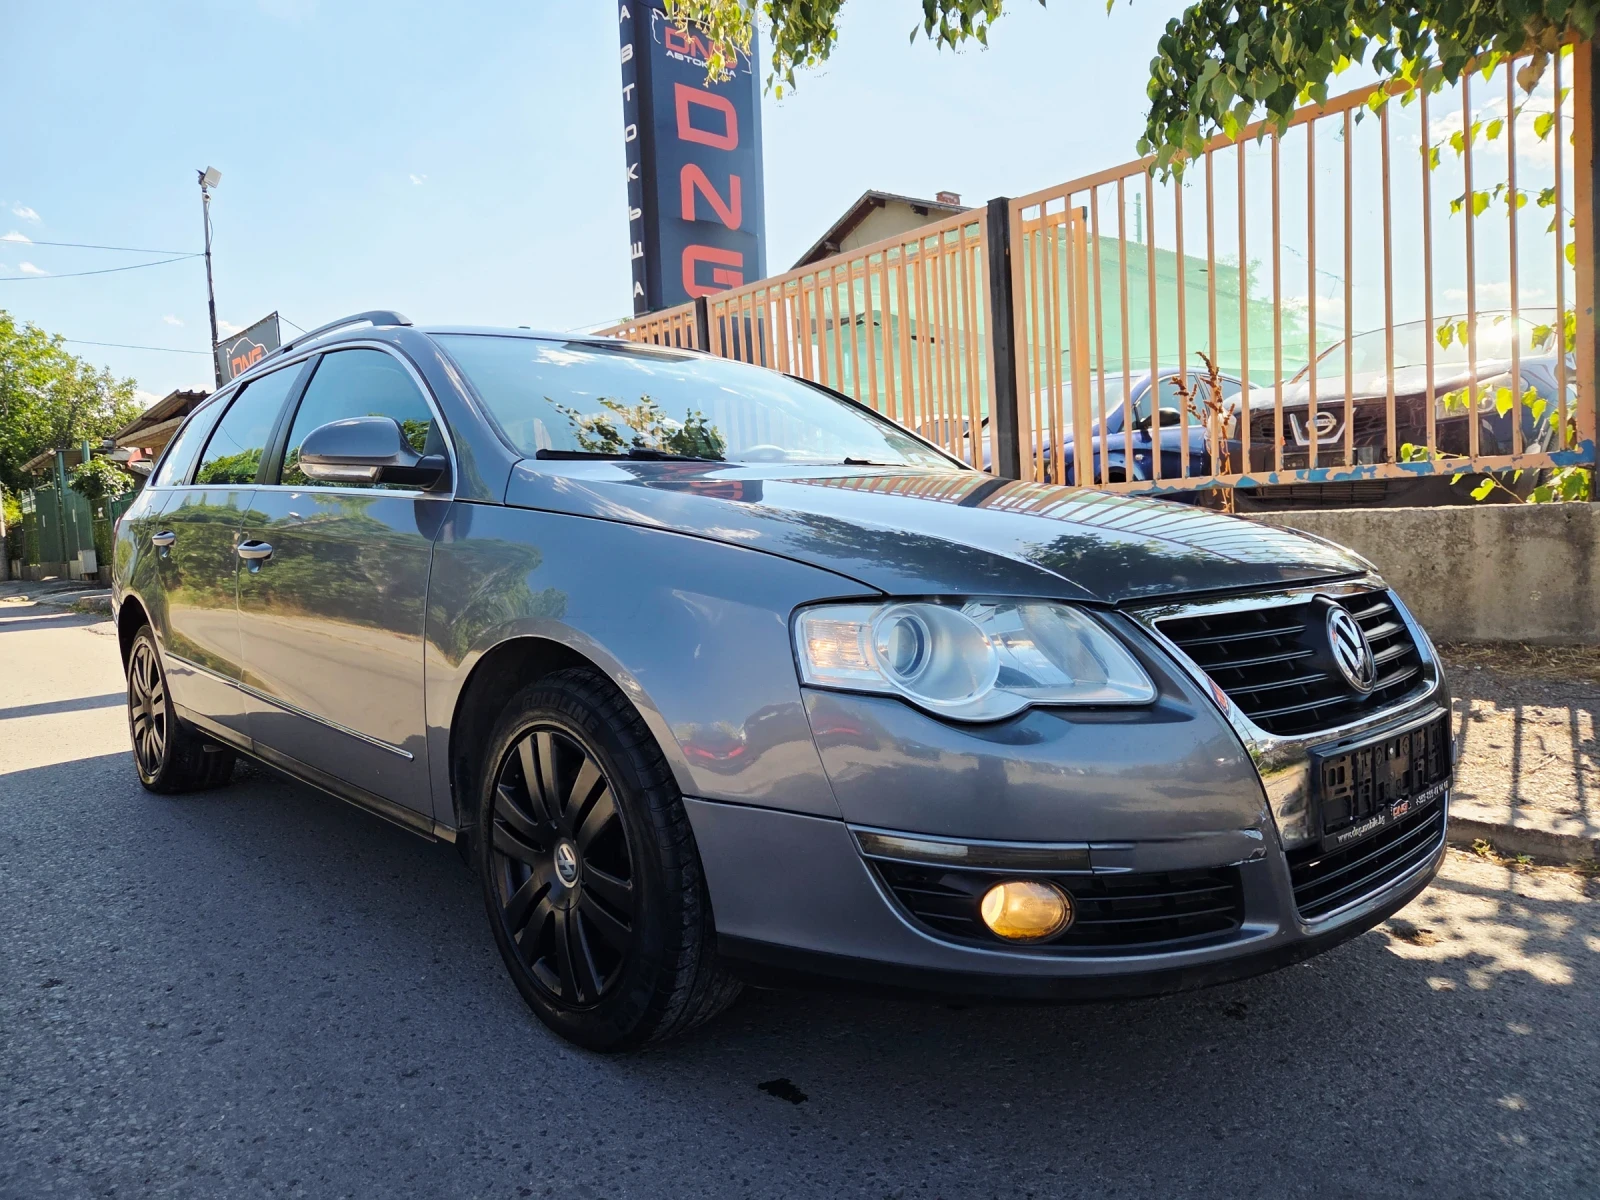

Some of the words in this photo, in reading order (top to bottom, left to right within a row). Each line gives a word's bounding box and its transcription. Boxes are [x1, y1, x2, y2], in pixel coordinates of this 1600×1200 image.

[619, 5, 645, 299] АВТОКЪЩА
[674, 82, 744, 299] DNG
[521, 691, 600, 734] GOLDLINE
